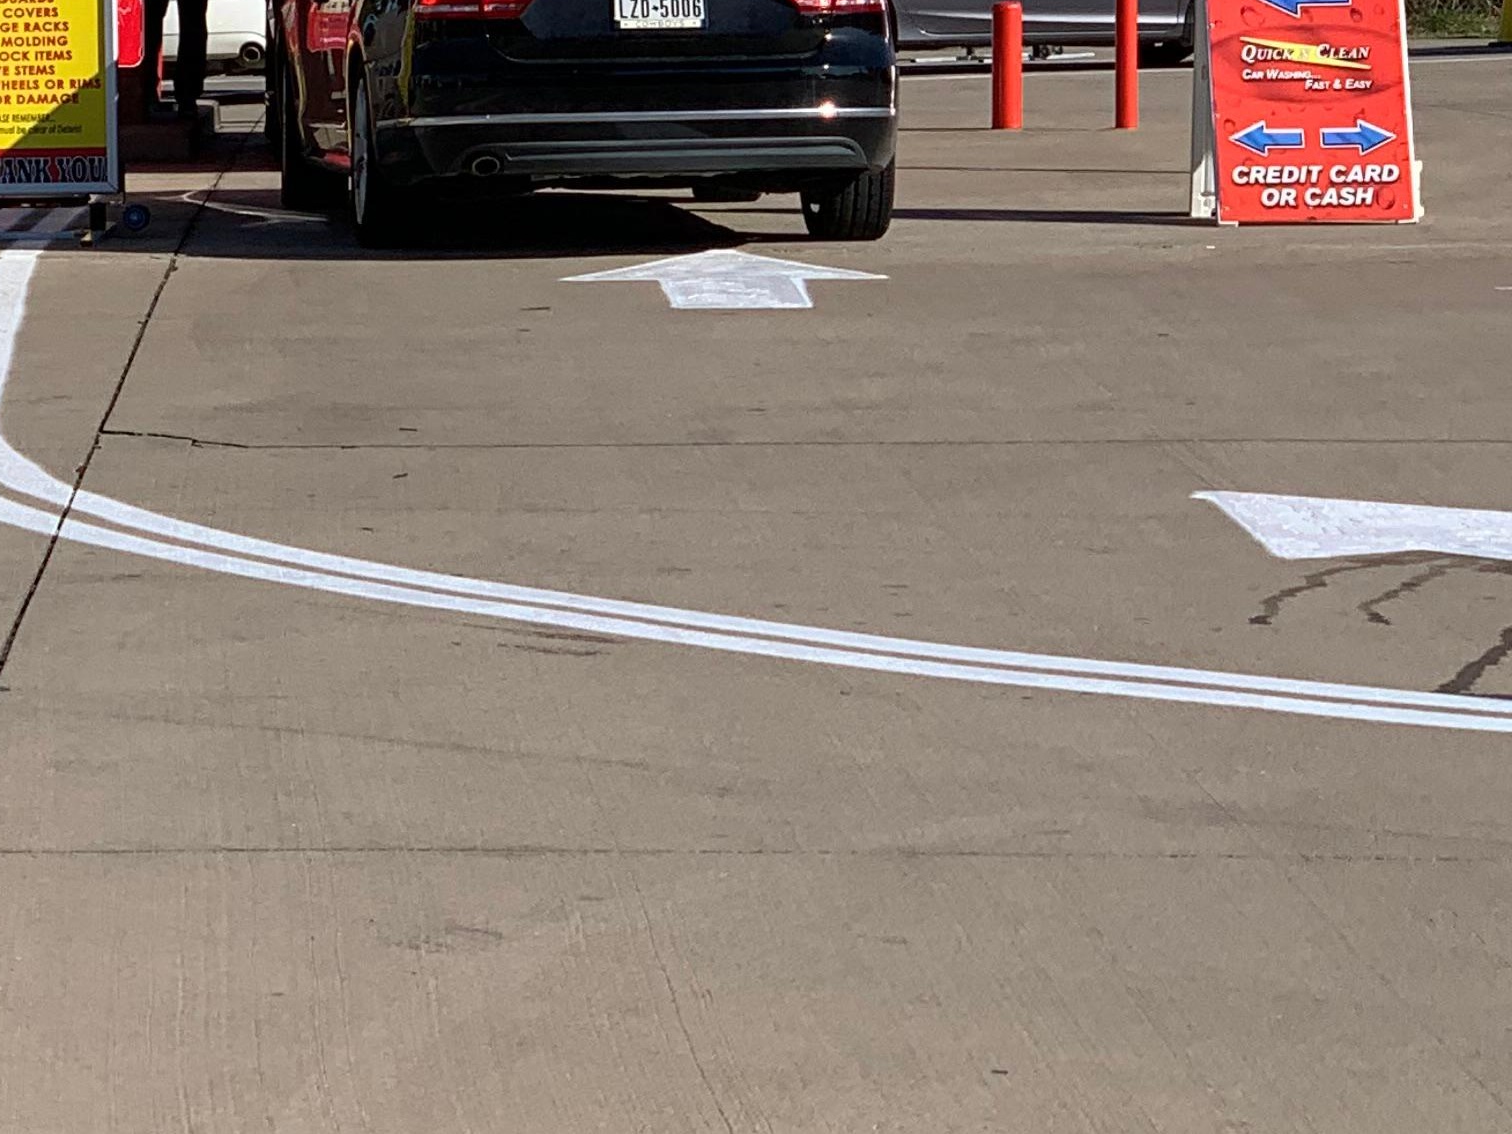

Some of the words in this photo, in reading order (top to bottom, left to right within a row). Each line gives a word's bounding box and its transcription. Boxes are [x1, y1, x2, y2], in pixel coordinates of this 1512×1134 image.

[2, 7, 59, 18] COVERS
[24, 21, 70, 32] RACKS
[1, 36, 68, 47] MOLDING
[35, 50, 73, 61] ITEMS
[1240, 44, 1295, 64] QUICK
[1316, 43, 1370, 59] CLEAN
[14, 65, 55, 76] STEMS
[1242, 69, 1264, 80] CAR
[44, 79, 65, 90] OR
[69, 78, 102, 90] RIMS
[1304, 79, 1331, 90] FAST
[1333, 78, 1342, 90] &
[1345, 78, 1373, 89] EASY
[16, 92, 80, 105] DAMAGE
[17, 125, 26, 135] be
[1231, 165, 1324, 185] CREDIT
[1329, 164, 1400, 184] CARD
[1261, 188, 1297, 207] OR
[1303, 187, 1375, 207] CASH
